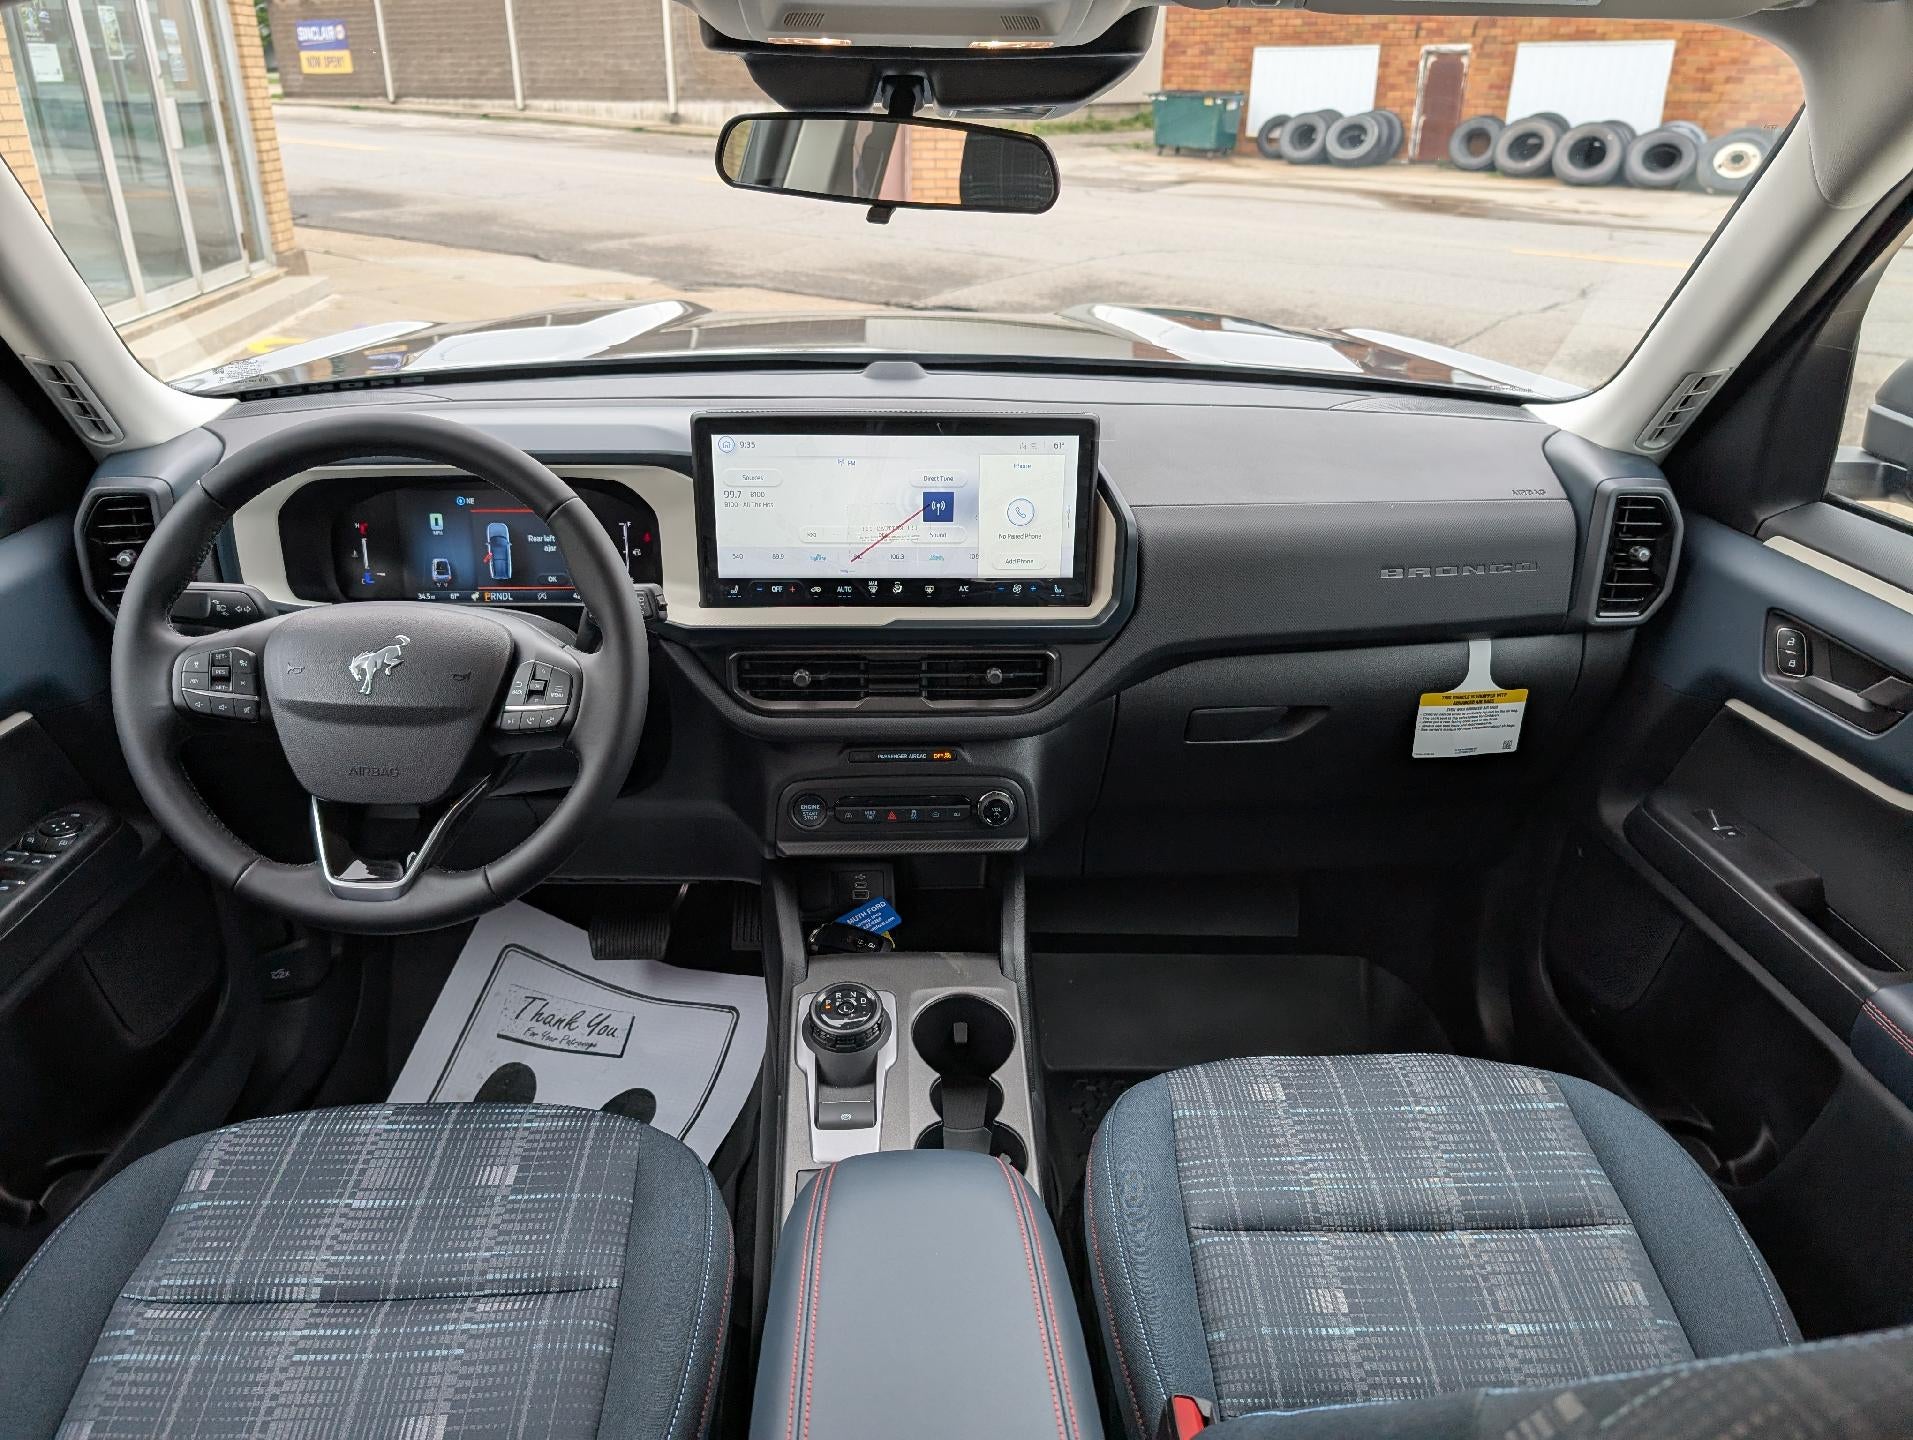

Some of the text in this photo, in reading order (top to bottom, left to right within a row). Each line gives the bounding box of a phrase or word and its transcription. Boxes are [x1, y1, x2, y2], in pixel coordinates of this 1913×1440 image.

[296, 26, 335, 41] SINCLAIR
[740, 441, 756, 449] 9:35
[528, 535, 544, 543] Rear
[1380, 561, 1538, 579] BRONCO
[348, 765, 400, 777] AIRBAG
[866, 901, 887, 914] FORD
[515, 995, 619, 1037] Thank You
[523, 1026, 539, 1038] For
